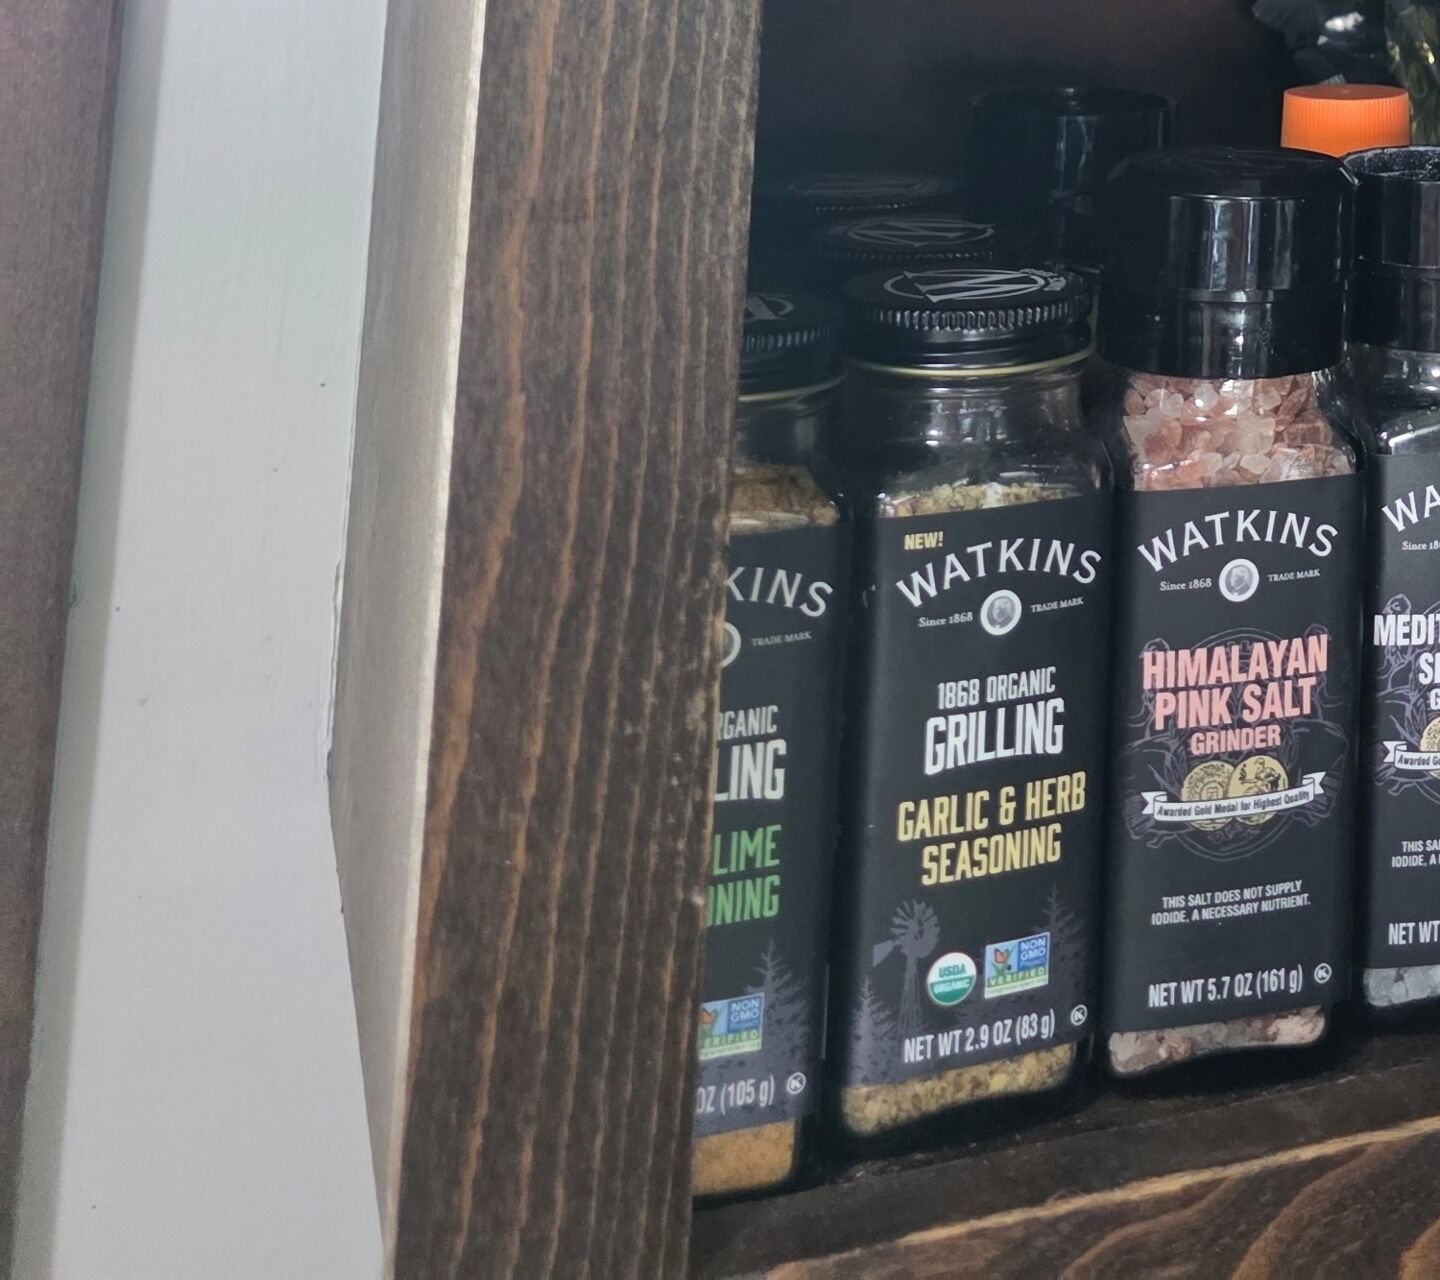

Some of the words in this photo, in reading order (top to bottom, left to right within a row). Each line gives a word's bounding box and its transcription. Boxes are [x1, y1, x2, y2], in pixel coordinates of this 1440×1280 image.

[904, 531, 944, 550] NEW!
[1136, 508, 1338, 572] WATKINS
[1402, 540, 1428, 550] Since
[895, 538, 1102, 608] WATKINS
[1142, 634, 1328, 690] HIMALAYAN
[938, 678, 980, 710] 1868
[986, 666, 1056, 703] ORGANIC
[1154, 686, 1232, 730] PINK
[1242, 676, 1316, 723] SALT
[924, 698, 1065, 776] GRILLING
[1190, 724, 1282, 756] GRINDER
[1398, 754, 1430, 766] Awarded
[898, 790, 990, 842] GARLIC
[999, 786, 1016, 826] &
[1024, 770, 1086, 821] HERB
[712, 824, 782, 876] LIME
[921, 822, 1062, 886] SEASONING
[1391, 855, 1428, 868] IODIDE,
[1429, 854, 1436, 866] A
[1402, 840, 1424, 852] THIS
[1151, 910, 1190, 926] IODIDE,
[1192, 909, 1200, 921] A
[1201, 902, 1259, 921] NECESSARY
[1260, 893, 1311, 912] NUTRIENT.
[1162, 896, 1186, 910] THIS
[1188, 892, 1212, 906] SALT
[1214, 890, 1241, 903] DOES
[1242, 886, 1263, 900] NOT
[1265, 880, 1302, 896] SUPPLY
[1020, 936, 1046, 951] NON
[1388, 922, 1415, 946] NET
[1418, 920, 1440, 943] WT
[1020, 948, 1046, 960] GMO
[938, 963, 966, 978] USDA
[989, 966, 1045, 986] VERIFIED
[1148, 982, 1178, 1008] NET
[1180, 978, 1205, 1004] WT
[1206, 976, 1231, 1000] 5.7
[1234, 972, 1253, 998] OZ
[1256, 967, 1285, 999] (161
[1288, 963, 1304, 993] g)
[730, 999, 760, 1012] NON
[730, 1008, 760, 1022] GMO
[904, 1037, 934, 1064] NET
[938, 1028, 962, 1057] WT
[964, 1024, 988, 1052] 2.9
[992, 1018, 1013, 1045] OZ
[1015, 1013, 1038, 1045] (83
[1040, 1008, 1055, 1037] g)
[720, 1078, 756, 1115] (105
[759, 1073, 775, 1108] g)
